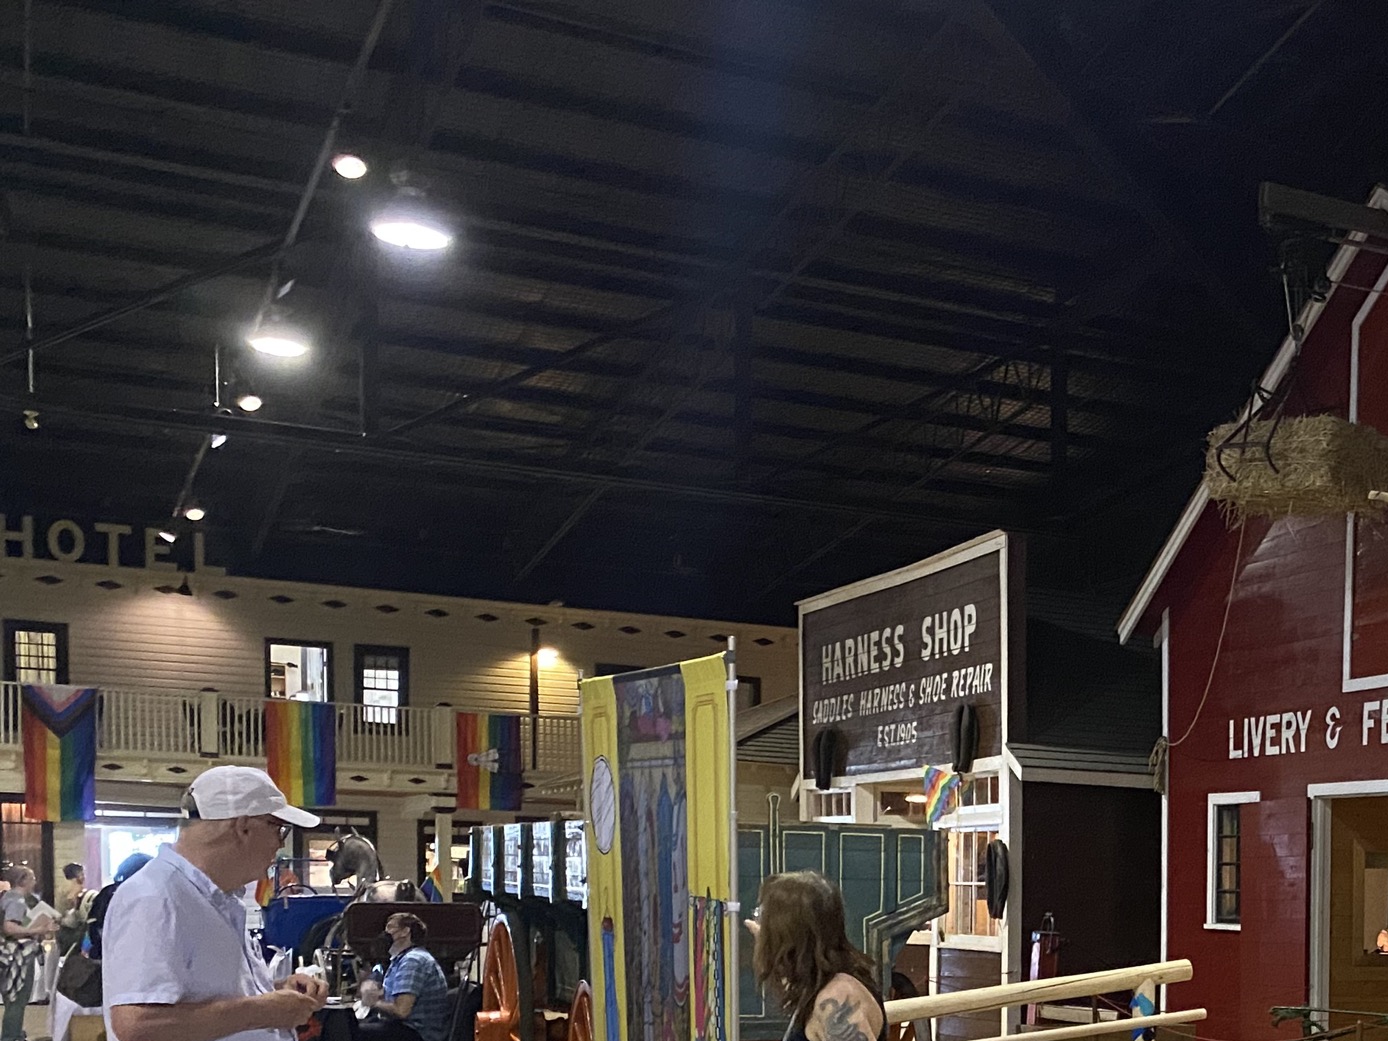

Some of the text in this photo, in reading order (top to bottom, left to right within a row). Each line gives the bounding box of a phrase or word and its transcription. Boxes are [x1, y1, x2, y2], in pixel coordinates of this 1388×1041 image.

[0, 513, 227, 576] HOTEL
[822, 603, 977, 685] HARNESS SHOP
[812, 663, 993, 724] SADDLES HARNESS & SHOE REPAIR
[1228, 709, 1312, 759] LIVERY
[1325, 706, 1343, 749] &
